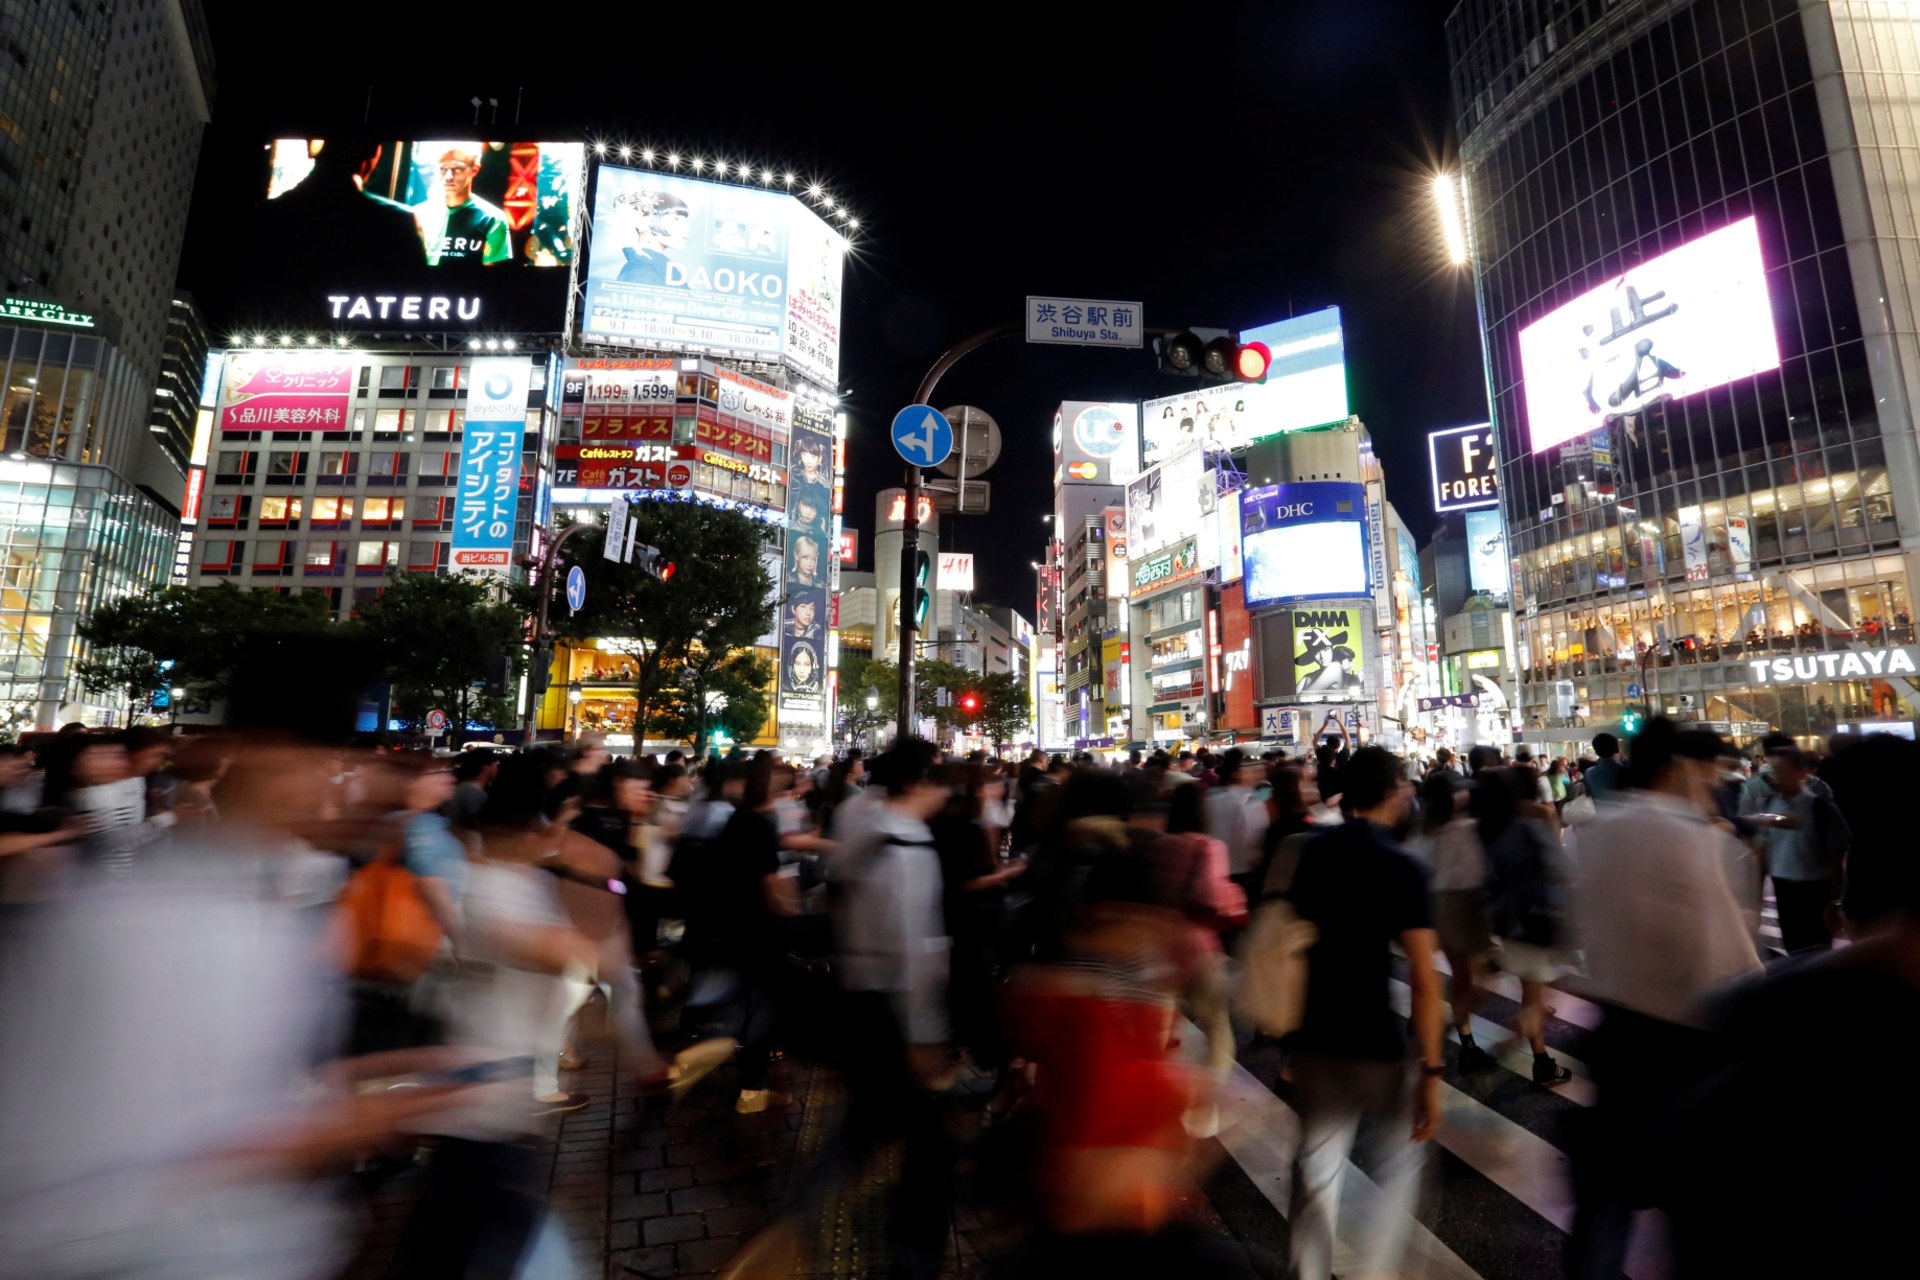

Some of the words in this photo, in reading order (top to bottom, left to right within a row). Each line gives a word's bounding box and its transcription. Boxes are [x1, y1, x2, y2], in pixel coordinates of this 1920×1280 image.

[666, 261, 783, 299] DAOKO
[5, 298, 64, 311] SHIBUYA
[328, 296, 481, 320] TATERU
[41, 309, 93, 323] CITY
[788, 294, 837, 336] ぱみゅぱみゅ
[1036, 303, 1134, 328] 渋谷駅前
[609, 319, 626, 331] 9.1
[644, 323, 675, 335] 18:00
[689, 328, 713, 340] 9.10
[729, 333, 759, 345] 18:00
[788, 319, 810, 342] 10.28
[1051, 326, 1097, 340] Shibuya
[1099, 328, 1122, 341] Sta.
[788, 333, 834, 370] 東京体育館
[578, 359, 673, 369] しゃぶしゃぶバイキング
[282, 375, 340, 388] クリニック
[566, 382, 583, 393] 9F
[713, 365, 790, 400] しゃぶしゃぶバイキング
[588, 384, 629, 400] 1,199円
[633, 384, 675, 400] 1,599円
[1156, 397, 1179, 407] Single
[1208, 387, 1224, 396] 9.13
[239, 407, 340, 424] 品川美容外科
[473, 401, 518, 415] eyecity
[743, 397, 787, 424] しゃぶ葉
[584, 418, 670, 435] プライス
[1079, 418, 1126, 446] UC
[696, 420, 769, 456] コンタクト
[634, 445, 679, 462] ガスト
[557, 469, 578, 482] 7F
[582, 468, 606, 479] Café
[608, 466, 661, 487] ガスト
[747, 463, 782, 485] ガスト
[1112, 467, 1134, 477] VISA
[462, 431, 495, 539] アイシティ
[489, 431, 516, 539] コンタクトの
[1256, 489, 1279, 501] Channel
[1276, 502, 1314, 519] DHC
[1369, 498, 1383, 546] Taisei
[460, 553, 505, 564] 当ビル5階
[1374, 550, 1385, 589] neon
[1295, 611, 1350, 628] DMM
[1295, 628, 1332, 647] FX
[1750, 648, 1916, 682] TSUTAYA
